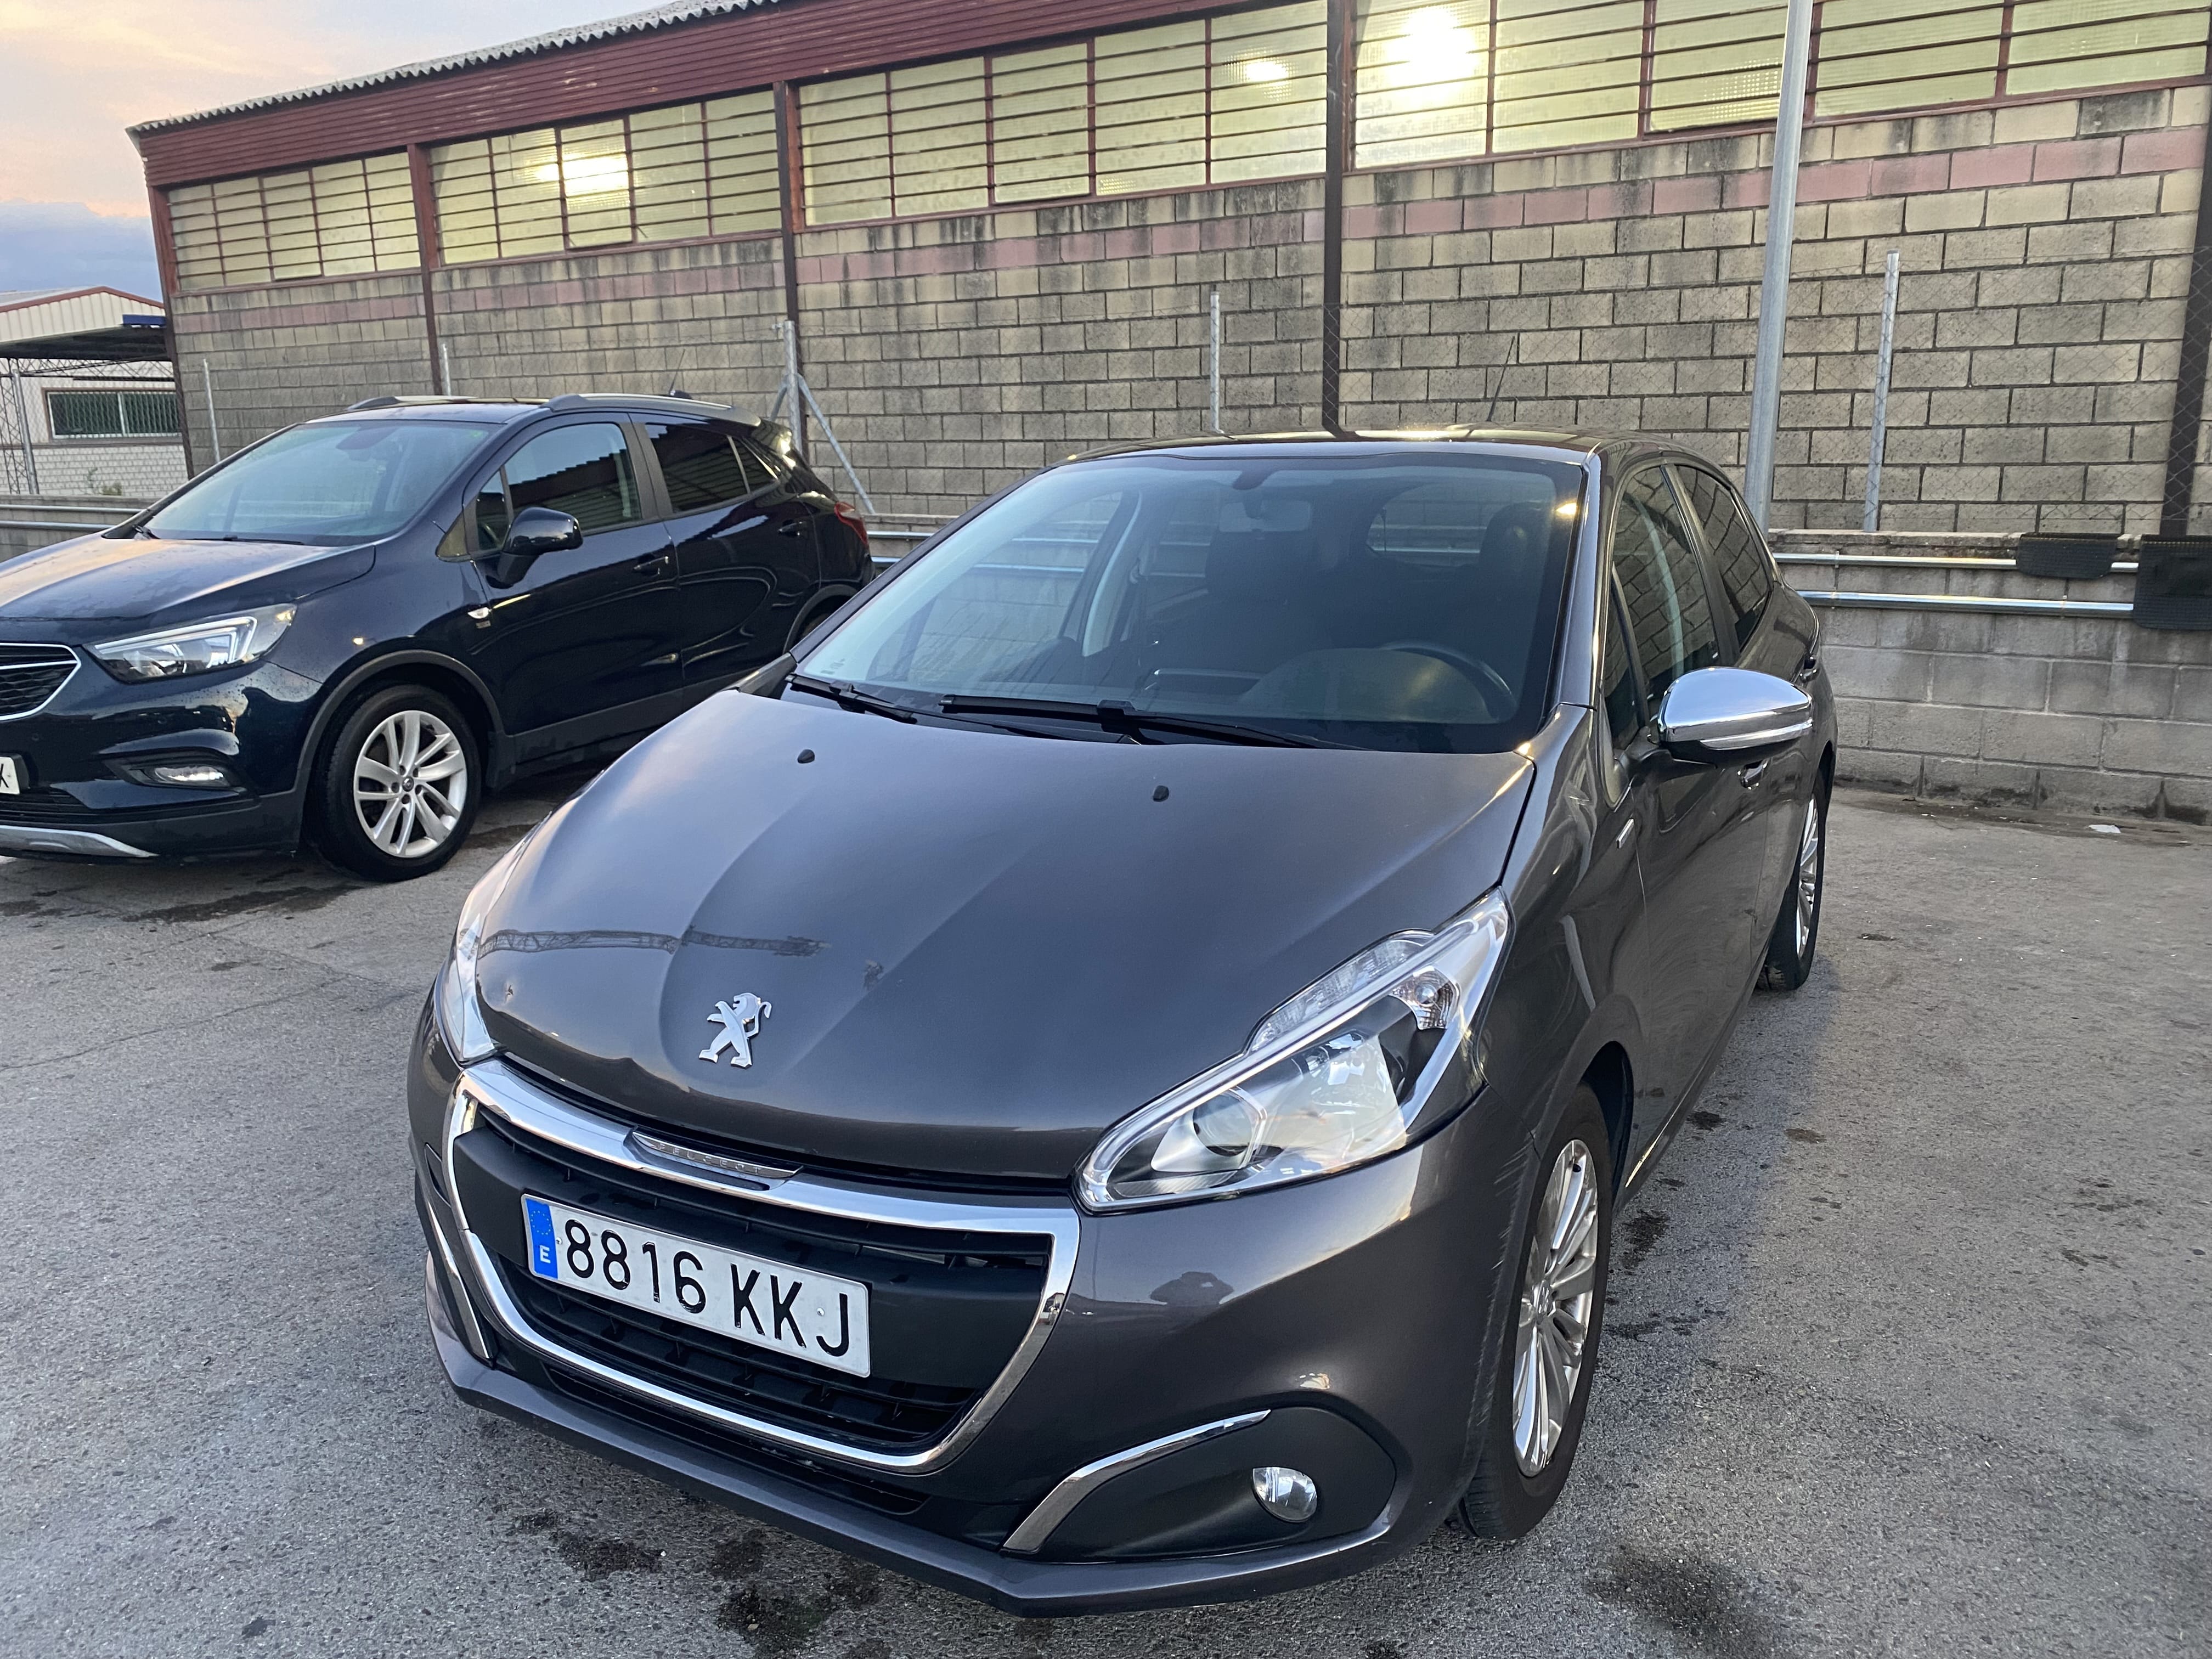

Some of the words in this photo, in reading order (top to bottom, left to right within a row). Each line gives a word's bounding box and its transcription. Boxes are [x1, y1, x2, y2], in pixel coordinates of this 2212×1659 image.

[657, 1142, 763, 1174] PEUGEOT
[539, 1245, 551, 1264] E
[565, 1219, 707, 1314] 8816
[730, 1263, 849, 1357] KKJ
